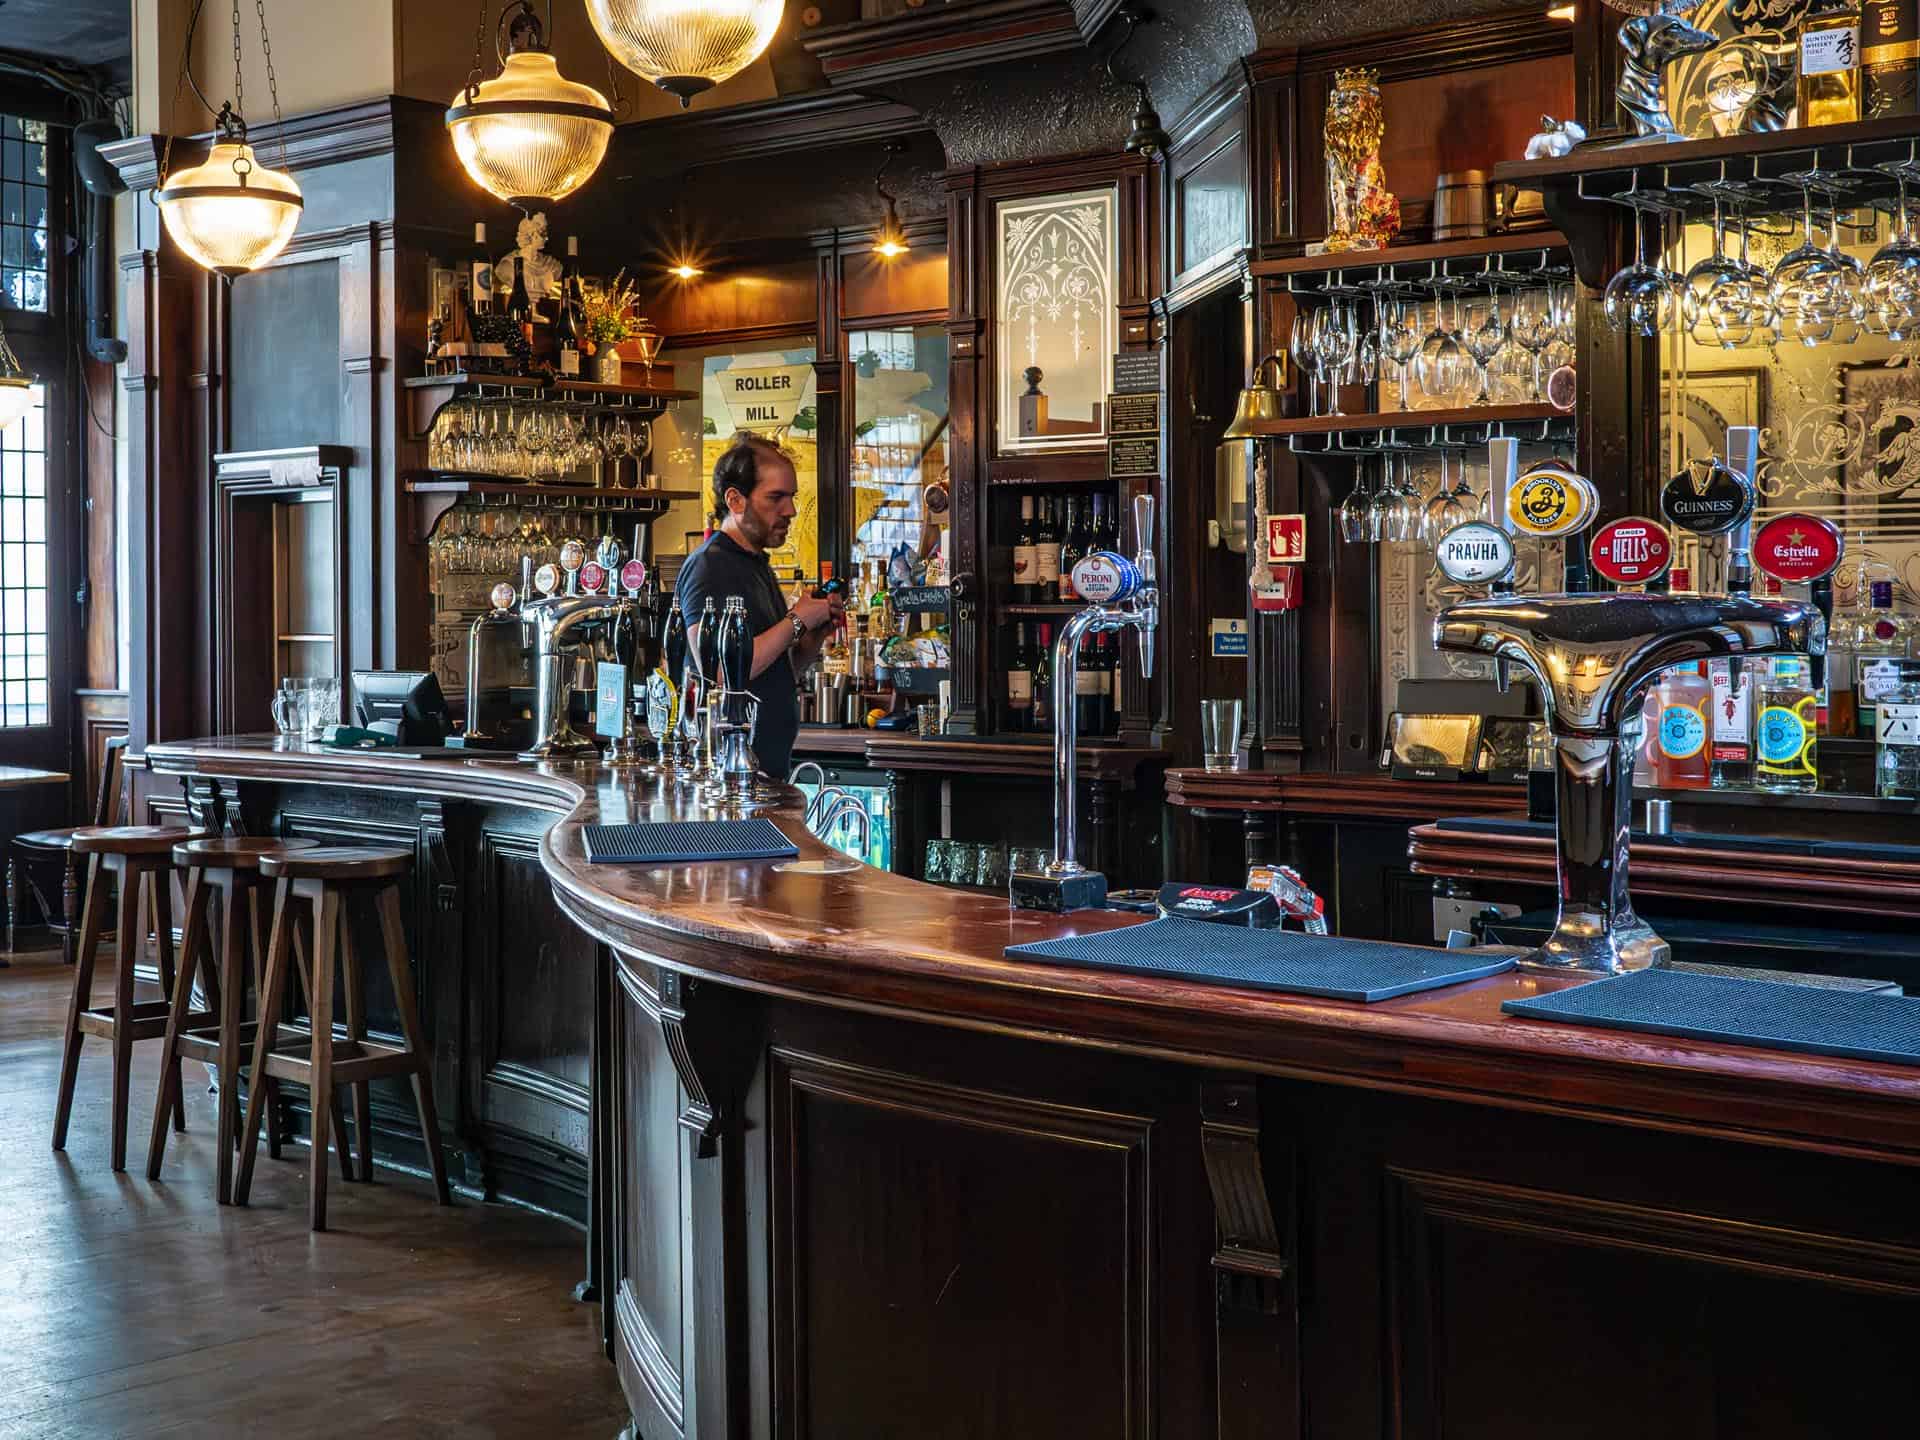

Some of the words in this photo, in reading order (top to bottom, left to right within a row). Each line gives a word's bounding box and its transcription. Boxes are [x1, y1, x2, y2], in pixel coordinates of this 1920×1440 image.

[735, 376, 790, 391] ROLLER
[746, 407, 778, 421] MILL
[1526, 477, 1562, 492] BROOKLYN
[1674, 500, 1734, 514] GUINNESS
[1527, 512, 1560, 525] PILSNER
[1448, 543, 1498, 561] PRAVHA
[1612, 537, 1649, 563] HELLS
[1773, 544, 1819, 558] Estrella
[1081, 573, 1112, 584] PERONI
[1713, 675, 1748, 688] BEEFR
